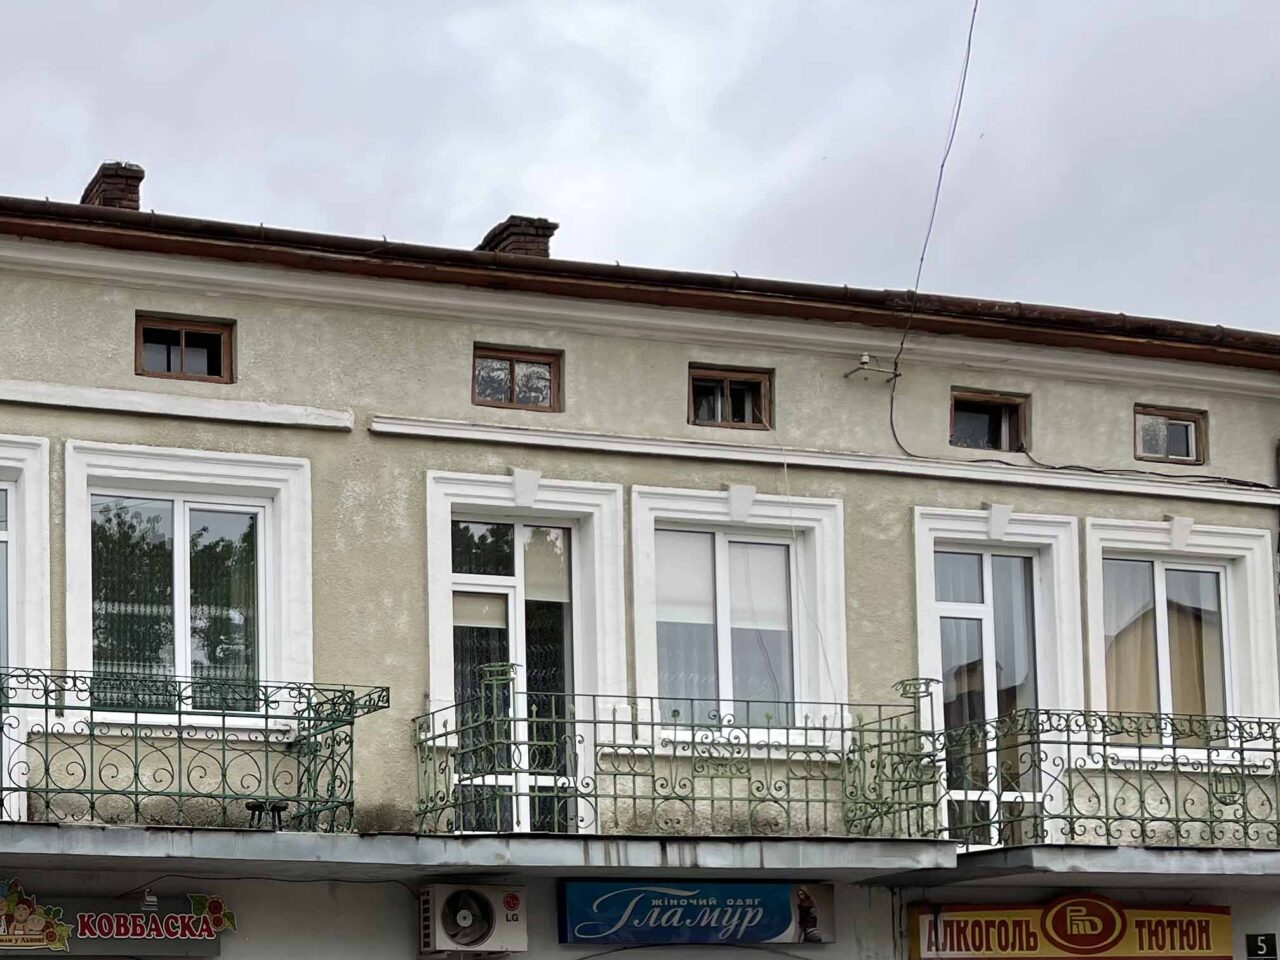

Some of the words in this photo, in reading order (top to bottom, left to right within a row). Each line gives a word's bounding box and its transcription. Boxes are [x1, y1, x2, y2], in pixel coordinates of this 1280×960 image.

[575, 886, 764, 940] Гламур
[651, 897, 717, 906] жіночий
[726, 898, 762, 906] одяг
[77, 912, 216, 940] КОВБАСКА
[505, 913, 519, 922] LG
[926, 918, 1039, 952] АЛКОГОЛЬ
[1134, 918, 1212, 951] ТЮТЮН
[1257, 936, 1267, 954] 5
